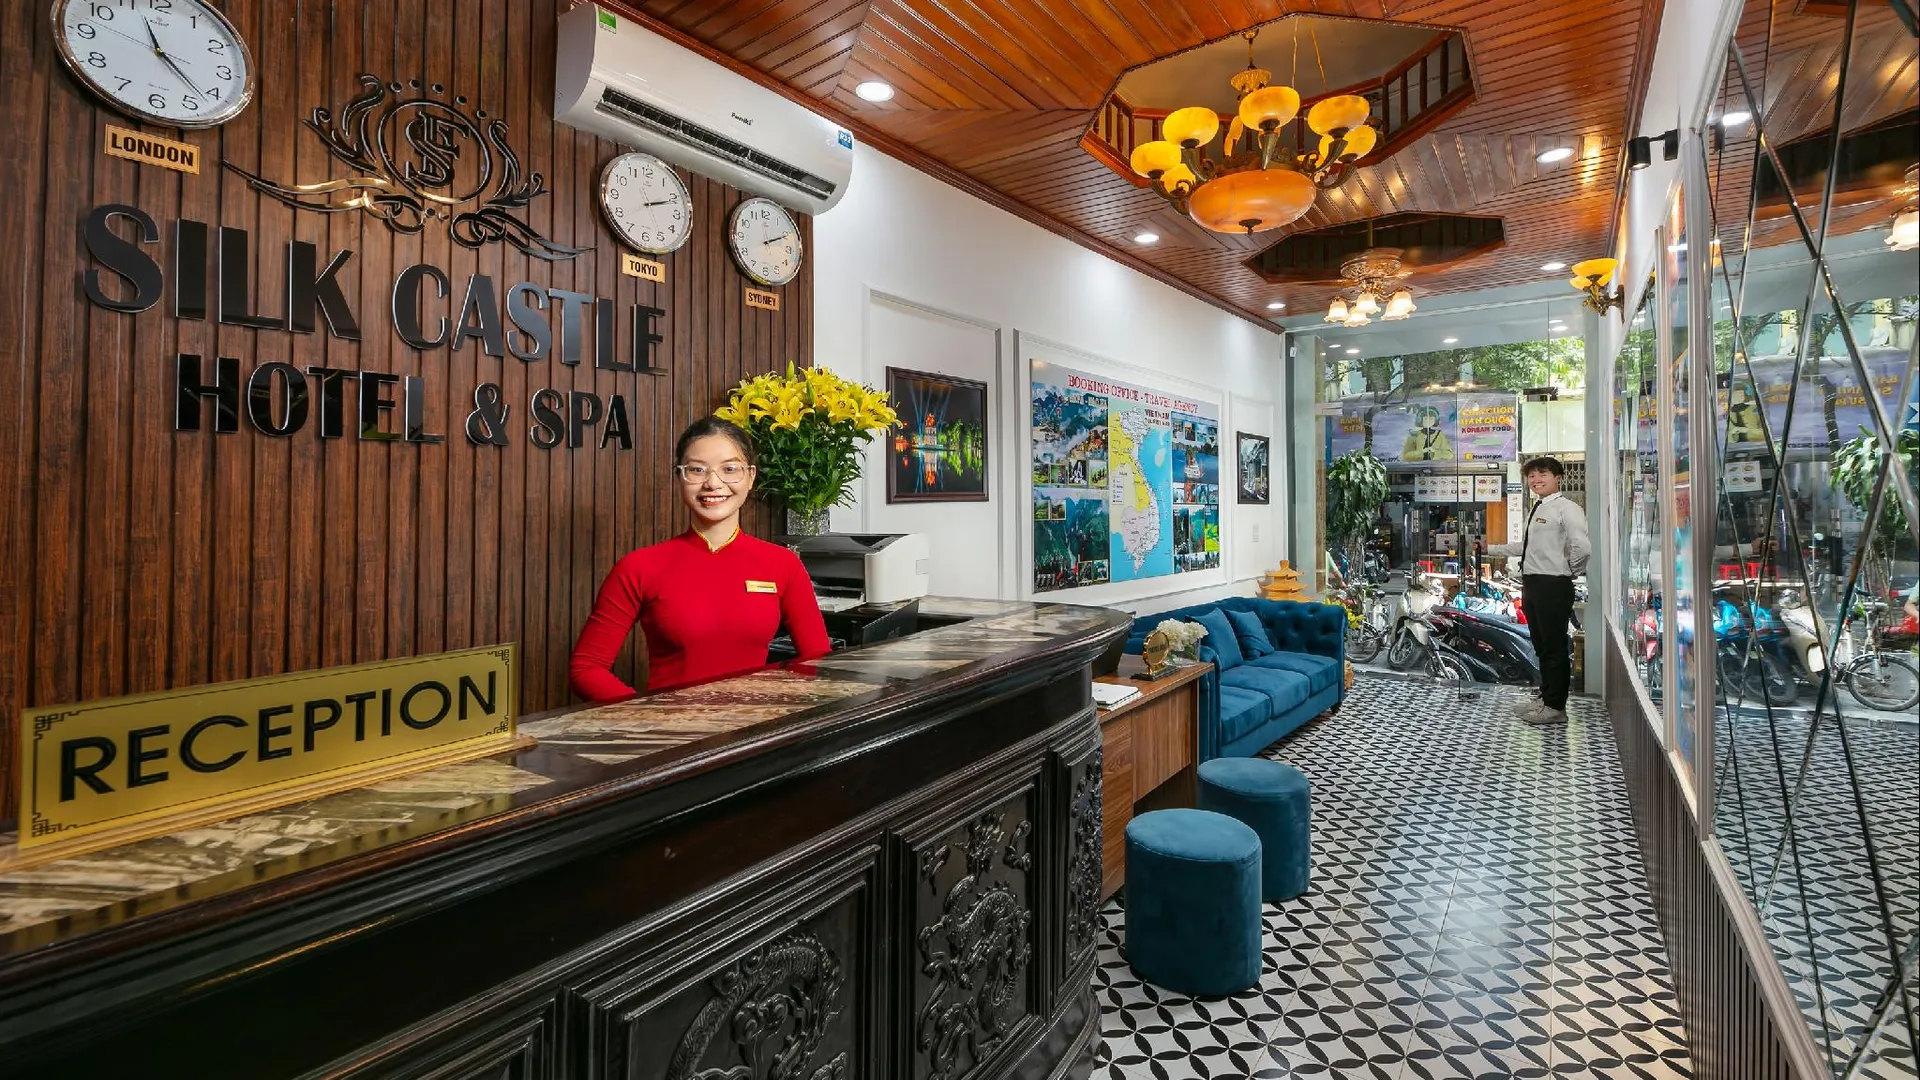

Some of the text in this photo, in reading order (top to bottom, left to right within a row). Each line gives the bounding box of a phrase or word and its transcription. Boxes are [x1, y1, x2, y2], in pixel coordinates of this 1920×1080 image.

[90, 2, 114, 21] 10
[77, 23, 96, 40] 9
[207, 39, 224, 56] 2
[87, 51, 107, 69] 8
[216, 65, 232, 81] 3
[114, 75, 132, 91] 7
[206, 87, 221, 101] 4
[148, 93, 166, 110] 6
[181, 95, 199, 111] 5
[839, 132, 852, 144] R32
[111, 132, 194, 167] LONDON
[628, 166, 637, 178] 11
[642, 166, 653, 179] 12
[615, 174, 627, 187] 10
[610, 188, 619, 200] 9
[669, 193, 678, 204] 2
[614, 206, 624, 218] 8
[672, 209, 681, 221] 3
[750, 210, 758, 220] 11
[761, 209, 771, 220] 12
[626, 221, 635, 233] 7
[668, 224, 676, 234] 4
[741, 219, 750, 229] 10
[641, 231, 650, 242] 6
[656, 231, 665, 242] 5
[737, 231, 744, 241] 9
[741, 247, 748, 256] 8
[785, 245, 792, 254] 3
[629, 259, 658, 277] TOKYO
[750, 259, 757, 268] 7
[762, 266, 769, 277] 6
[773, 265, 780, 275] 5
[82, 203, 669, 377] SILK CASTLE
[748, 291, 776, 307] SYDNEY
[1067, 375, 1109, 394] BOOKING
[1111, 385, 1139, 402] OFFICE
[1144, 392, 1171, 408] TRAVEL
[1173, 400, 1199, 414] AGENCY
[175, 352, 634, 451] HOTEL & SPA
[1144, 408, 1170, 420] VIETNAM
[59, 670, 497, 803] RECEPTION
